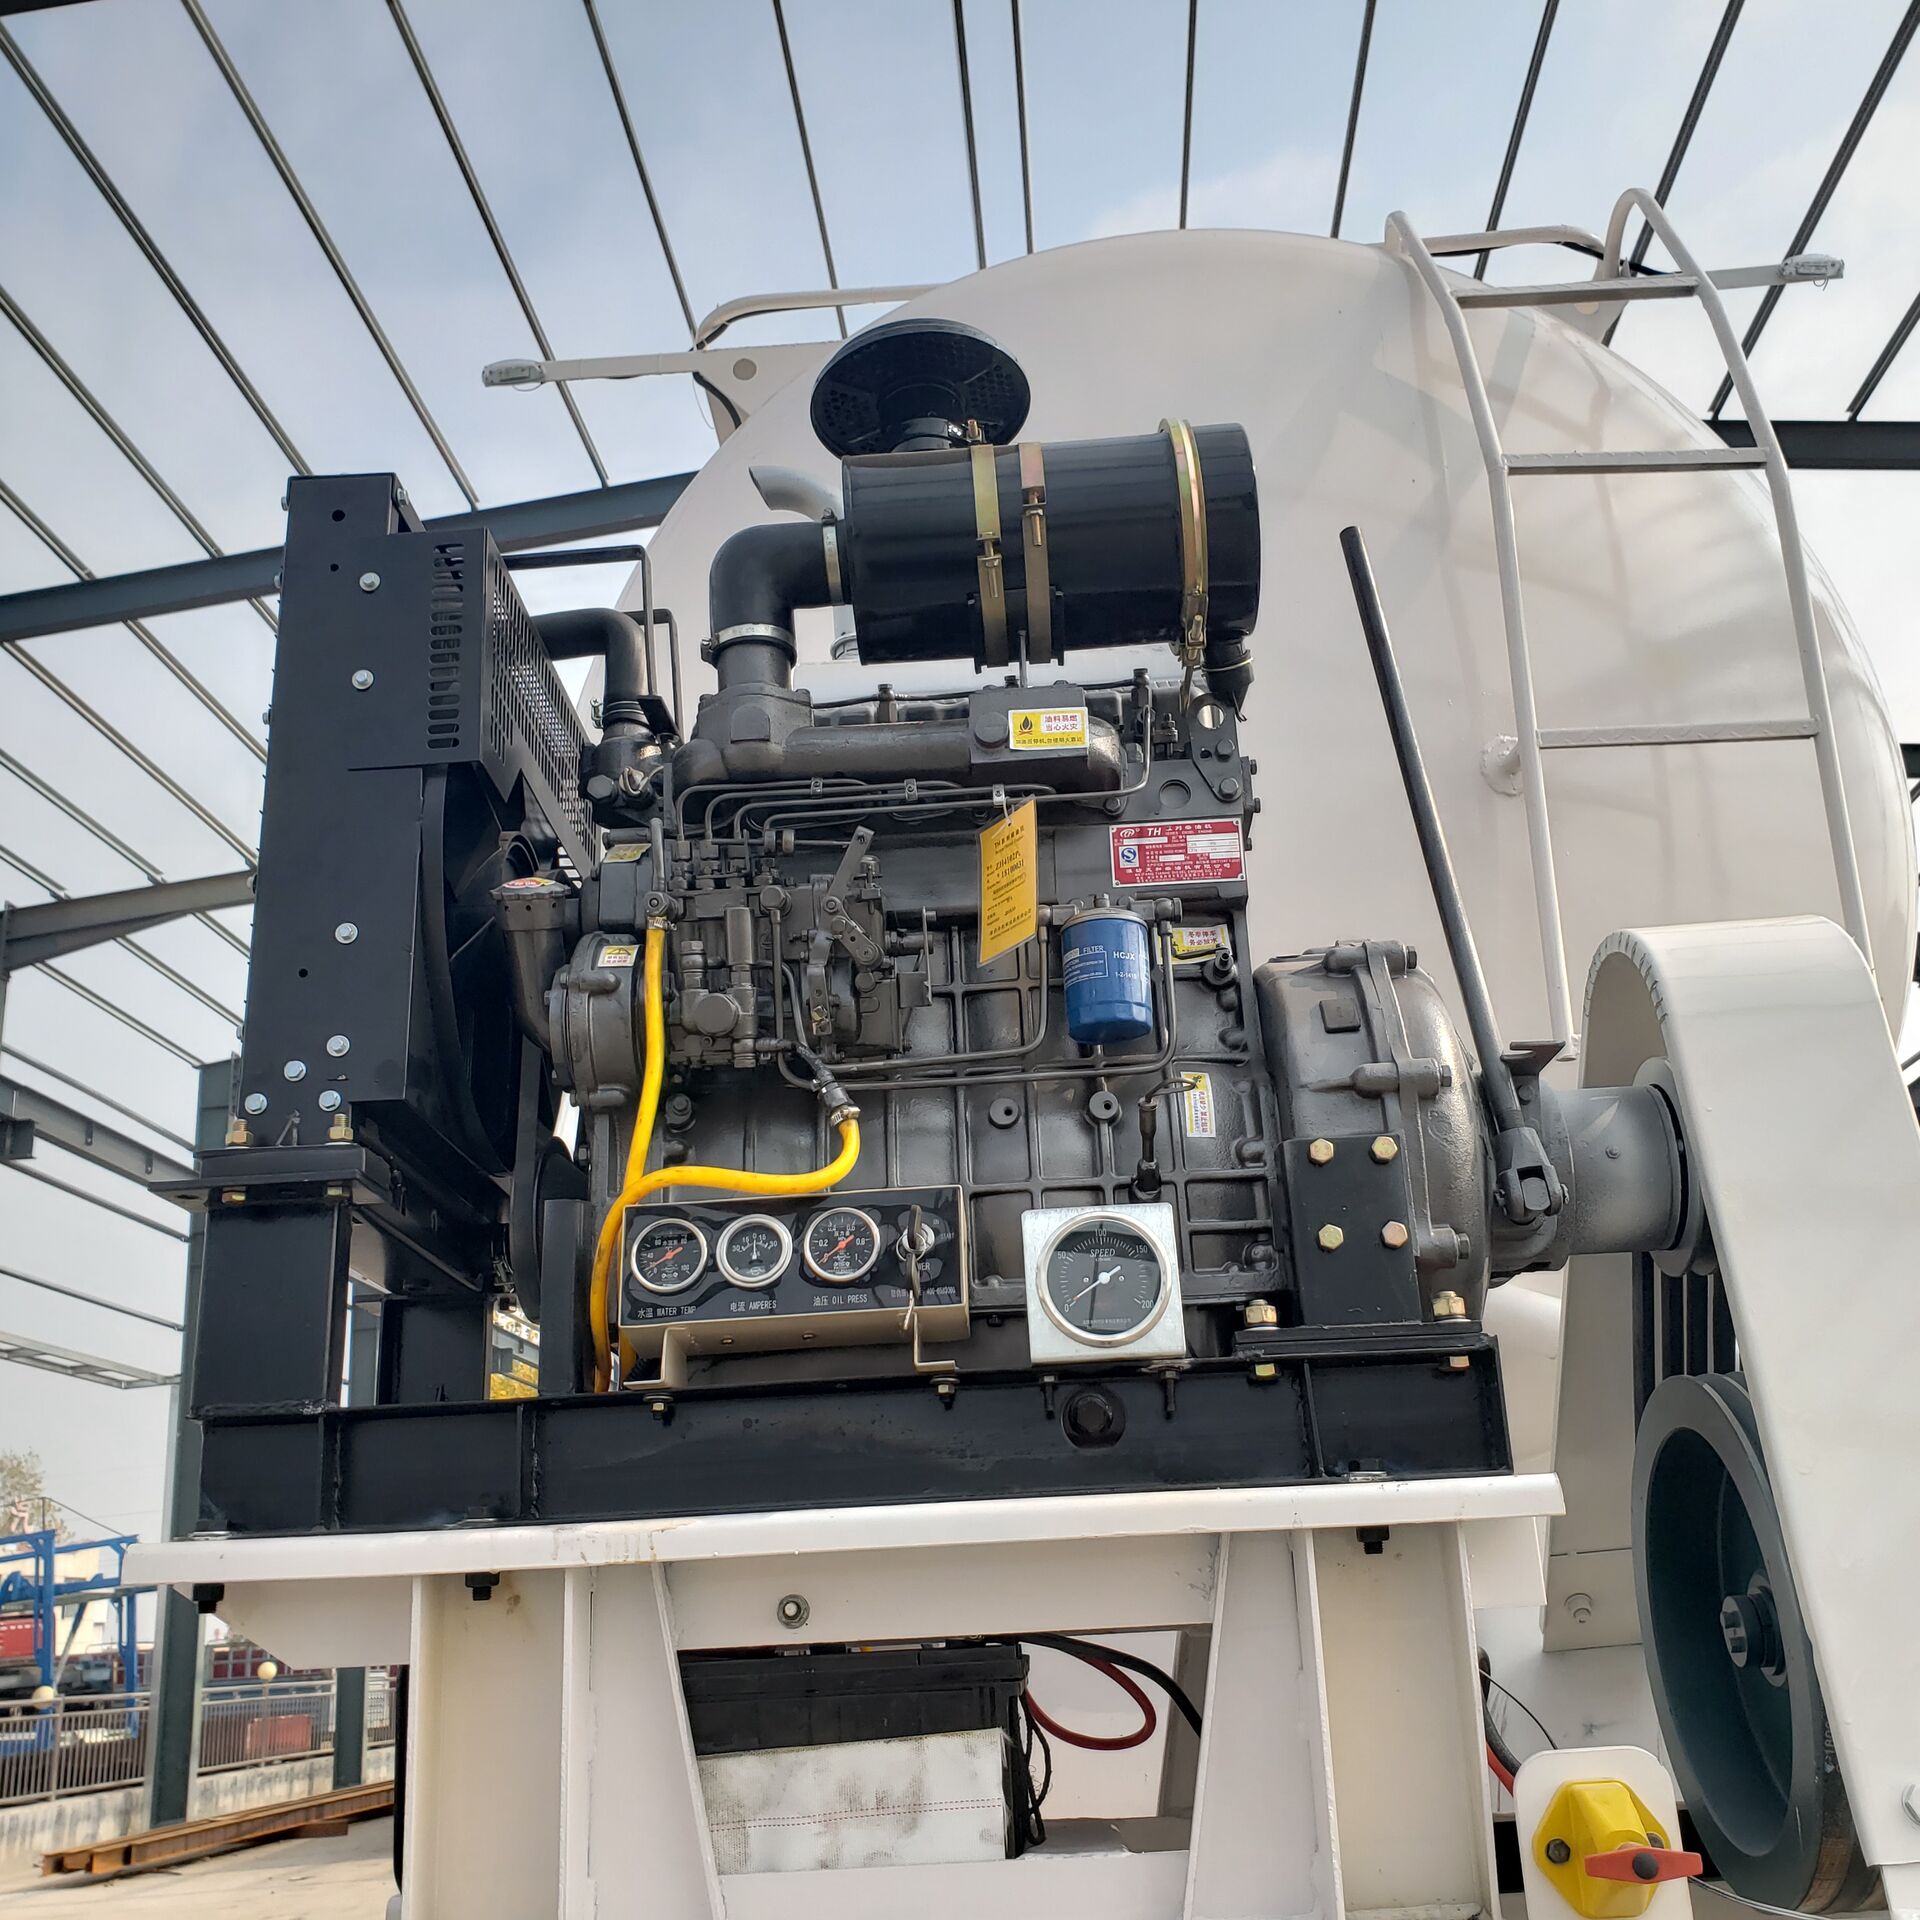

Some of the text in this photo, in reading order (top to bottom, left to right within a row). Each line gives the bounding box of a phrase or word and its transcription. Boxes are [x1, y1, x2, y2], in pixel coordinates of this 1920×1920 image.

[1045, 714, 1078, 723] 油料易燃
[1046, 723, 1078, 732] 当心火灾
[1147, 827, 1162, 836] TH
[1083, 945, 1104, 954] FILTER
[1113, 951, 1136, 961] HCJX
[846, 1223, 856, 1231] 0.6
[752, 1232, 757, 1240] 0
[759, 1233, 767, 1241] 15
[1095, 1228, 1107, 1237] 100
[769, 1240, 778, 1248] 30
[818, 1239, 829, 1247] 0.2
[855, 1237, 866, 1246] 0.8
[1090, 1247, 1116, 1257] SPEED
[1136, 1245, 1148, 1254] 150
[1057, 1251, 1067, 1259] 50
[813, 1293, 868, 1306] 油压 OIL PRESS
[731, 1300, 777, 1313] 电流 AMPERES
[1064, 1304, 1069, 1313] 0
[1141, 1300, 1154, 1309] 200
[637, 1305, 697, 1319] 水温 WATER TEMP
